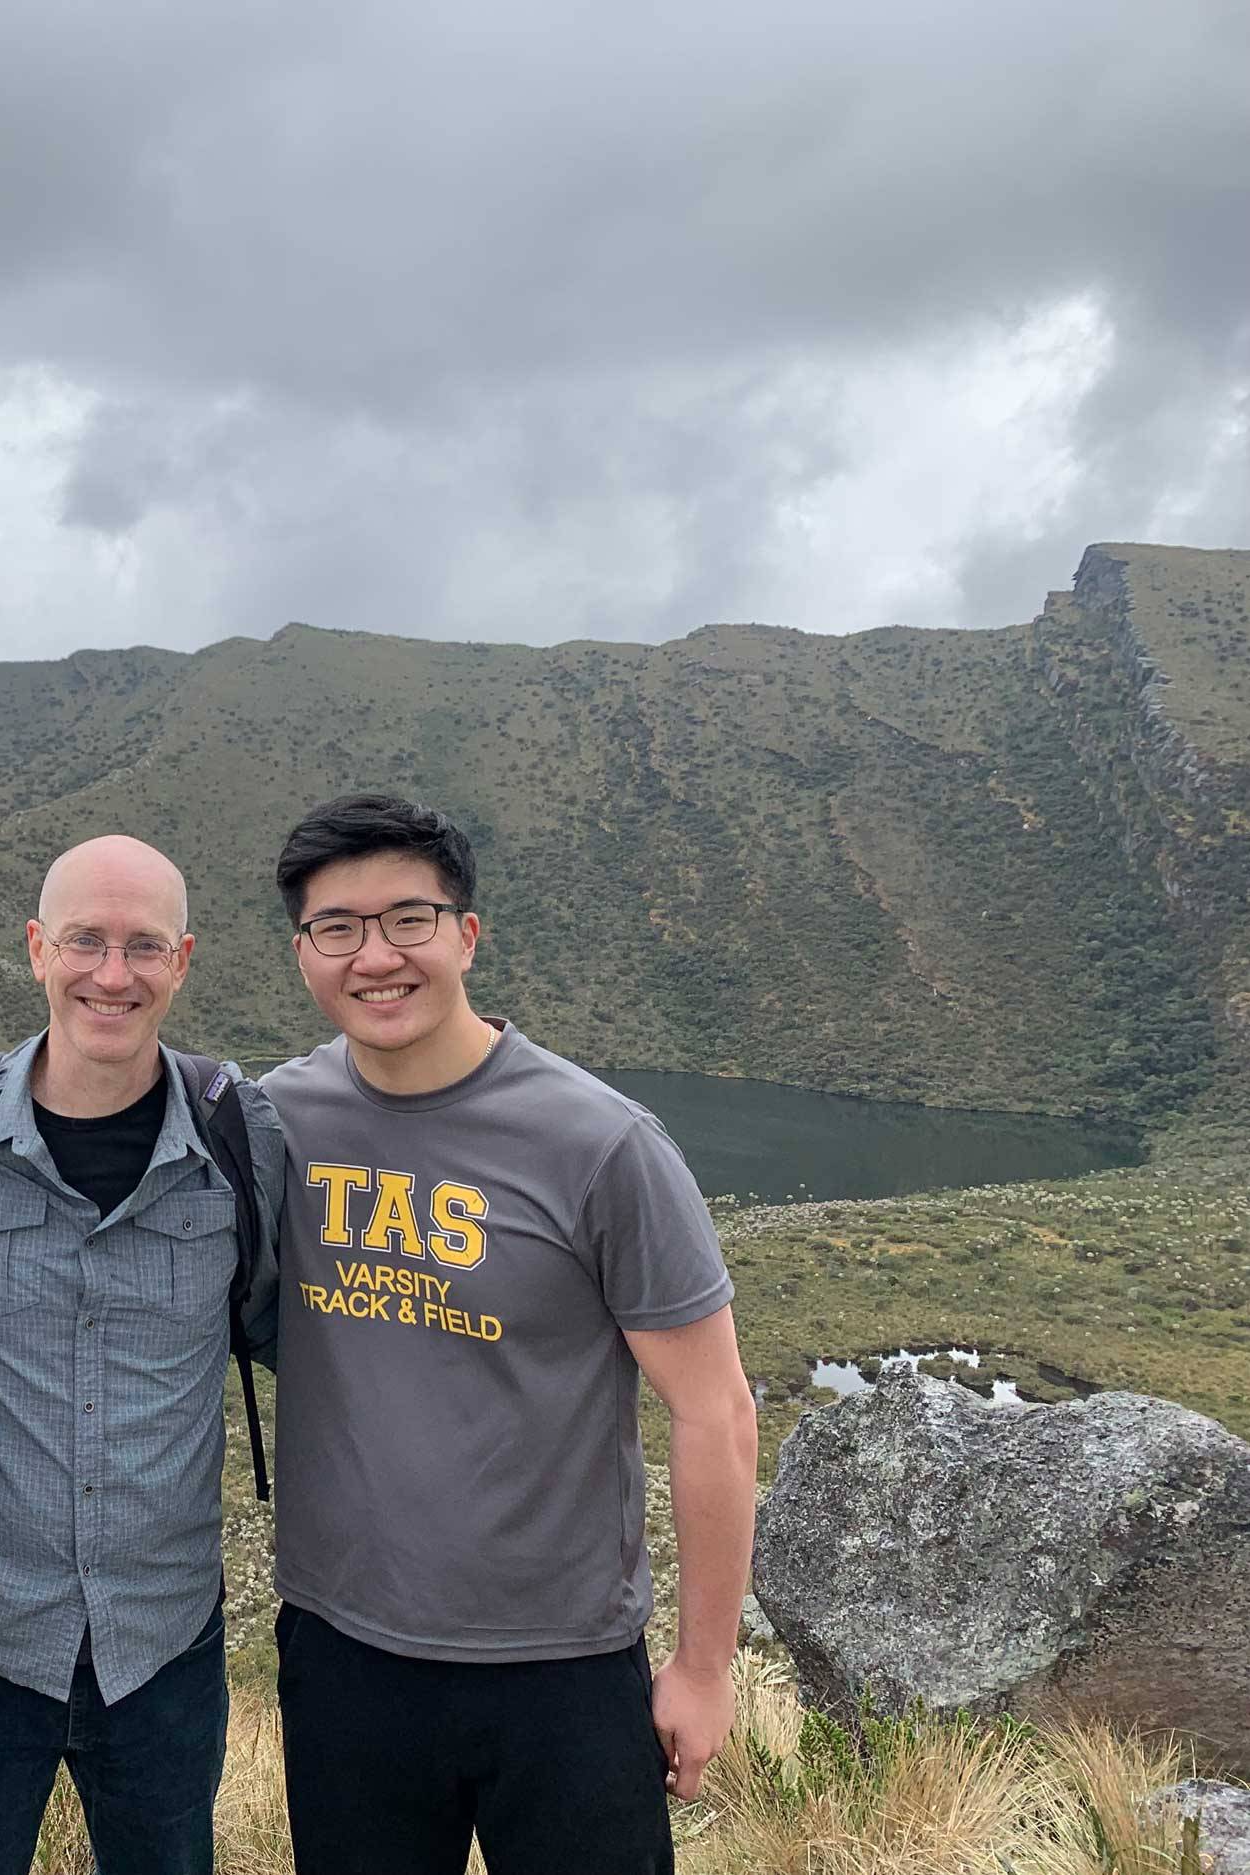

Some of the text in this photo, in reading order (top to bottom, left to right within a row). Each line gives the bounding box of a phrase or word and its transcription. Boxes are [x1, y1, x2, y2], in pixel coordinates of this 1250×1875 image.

[307, 1163, 489, 1270] TAS
[336, 1260, 451, 1303] VARSITY
[299, 1282, 503, 1341] TRACK & FIELD
